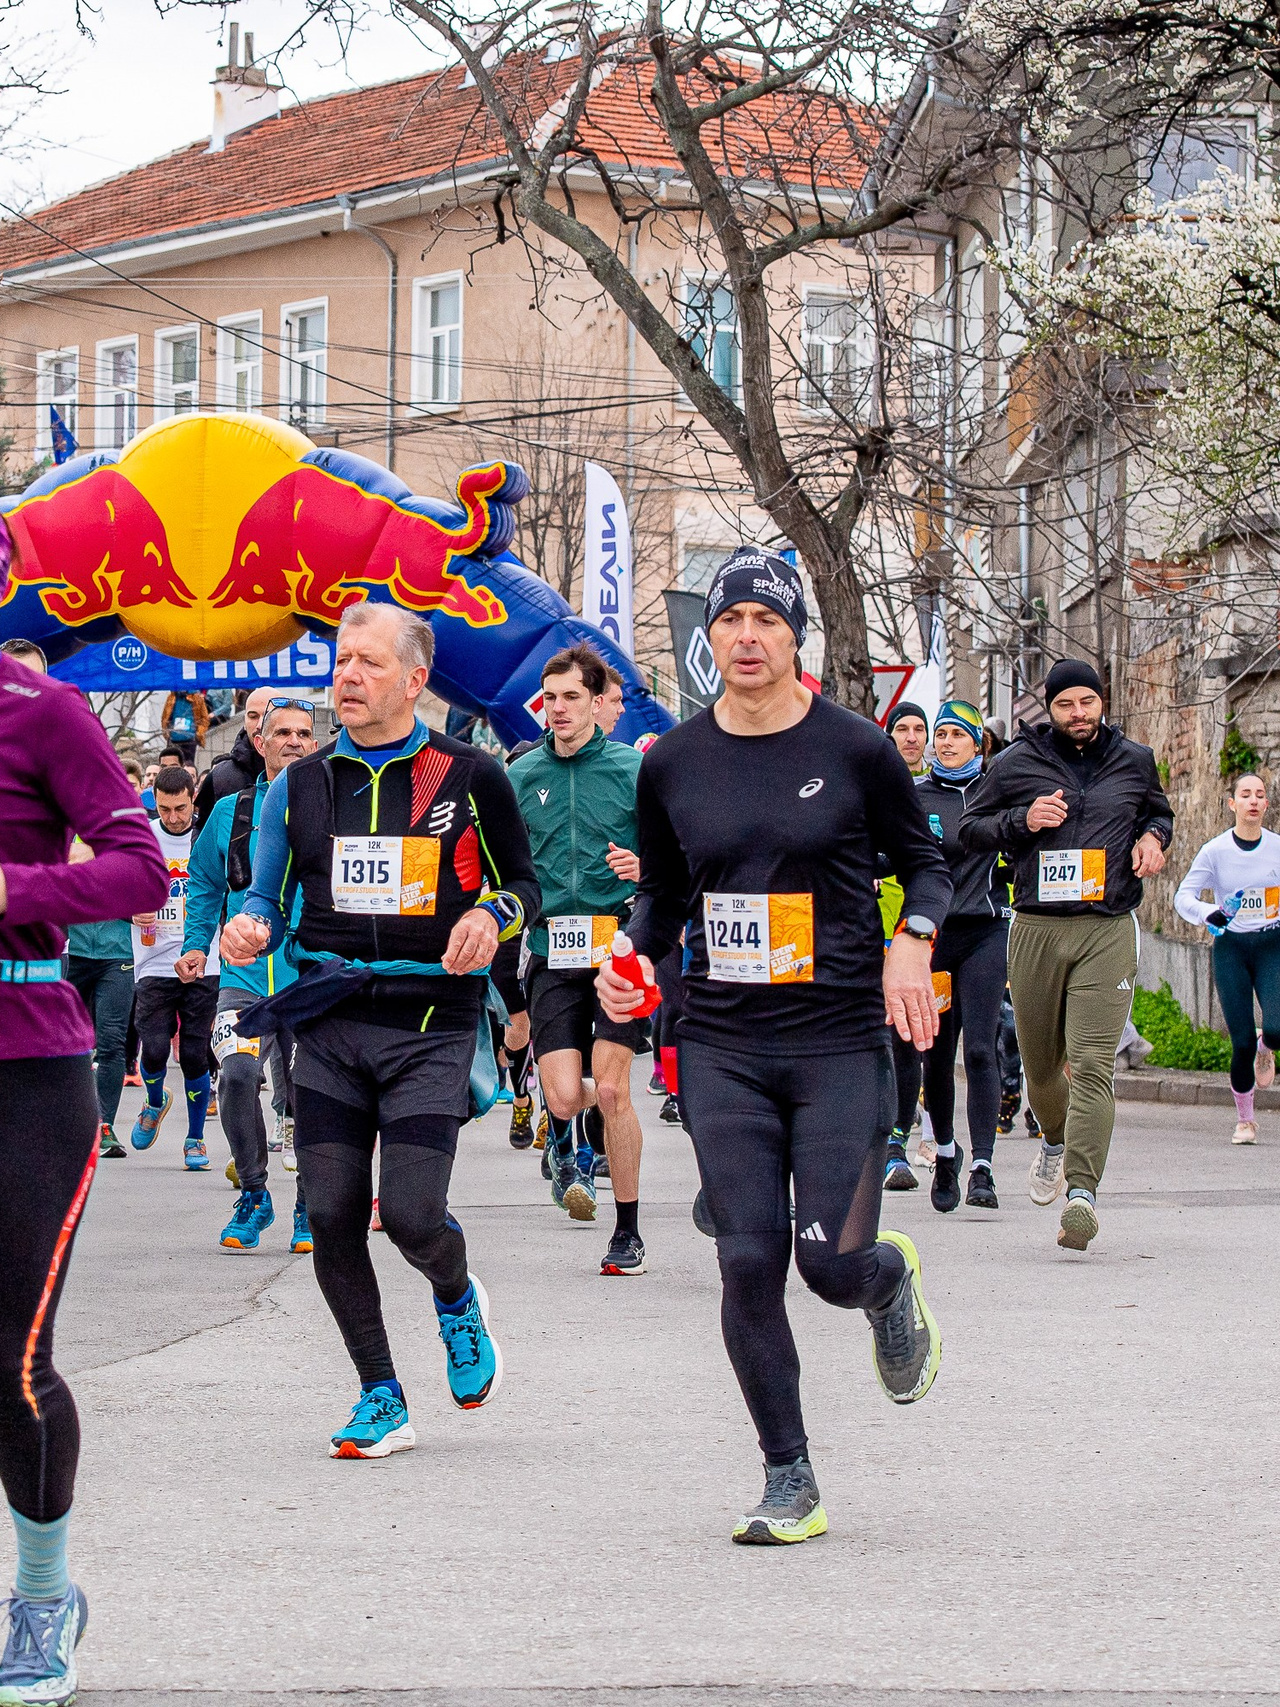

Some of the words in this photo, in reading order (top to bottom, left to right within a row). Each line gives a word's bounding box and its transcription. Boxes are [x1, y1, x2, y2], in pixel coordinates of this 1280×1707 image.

[118, 646, 141, 658] P/H
[368, 841, 381, 849] 12K
[341, 860, 389, 884] 1315
[1043, 866, 1076, 881] 1247
[732, 899, 745, 908] 12K
[1242, 897, 1262, 908] 200
[552, 932, 585, 948] 1398
[708, 920, 761, 948] 1244
